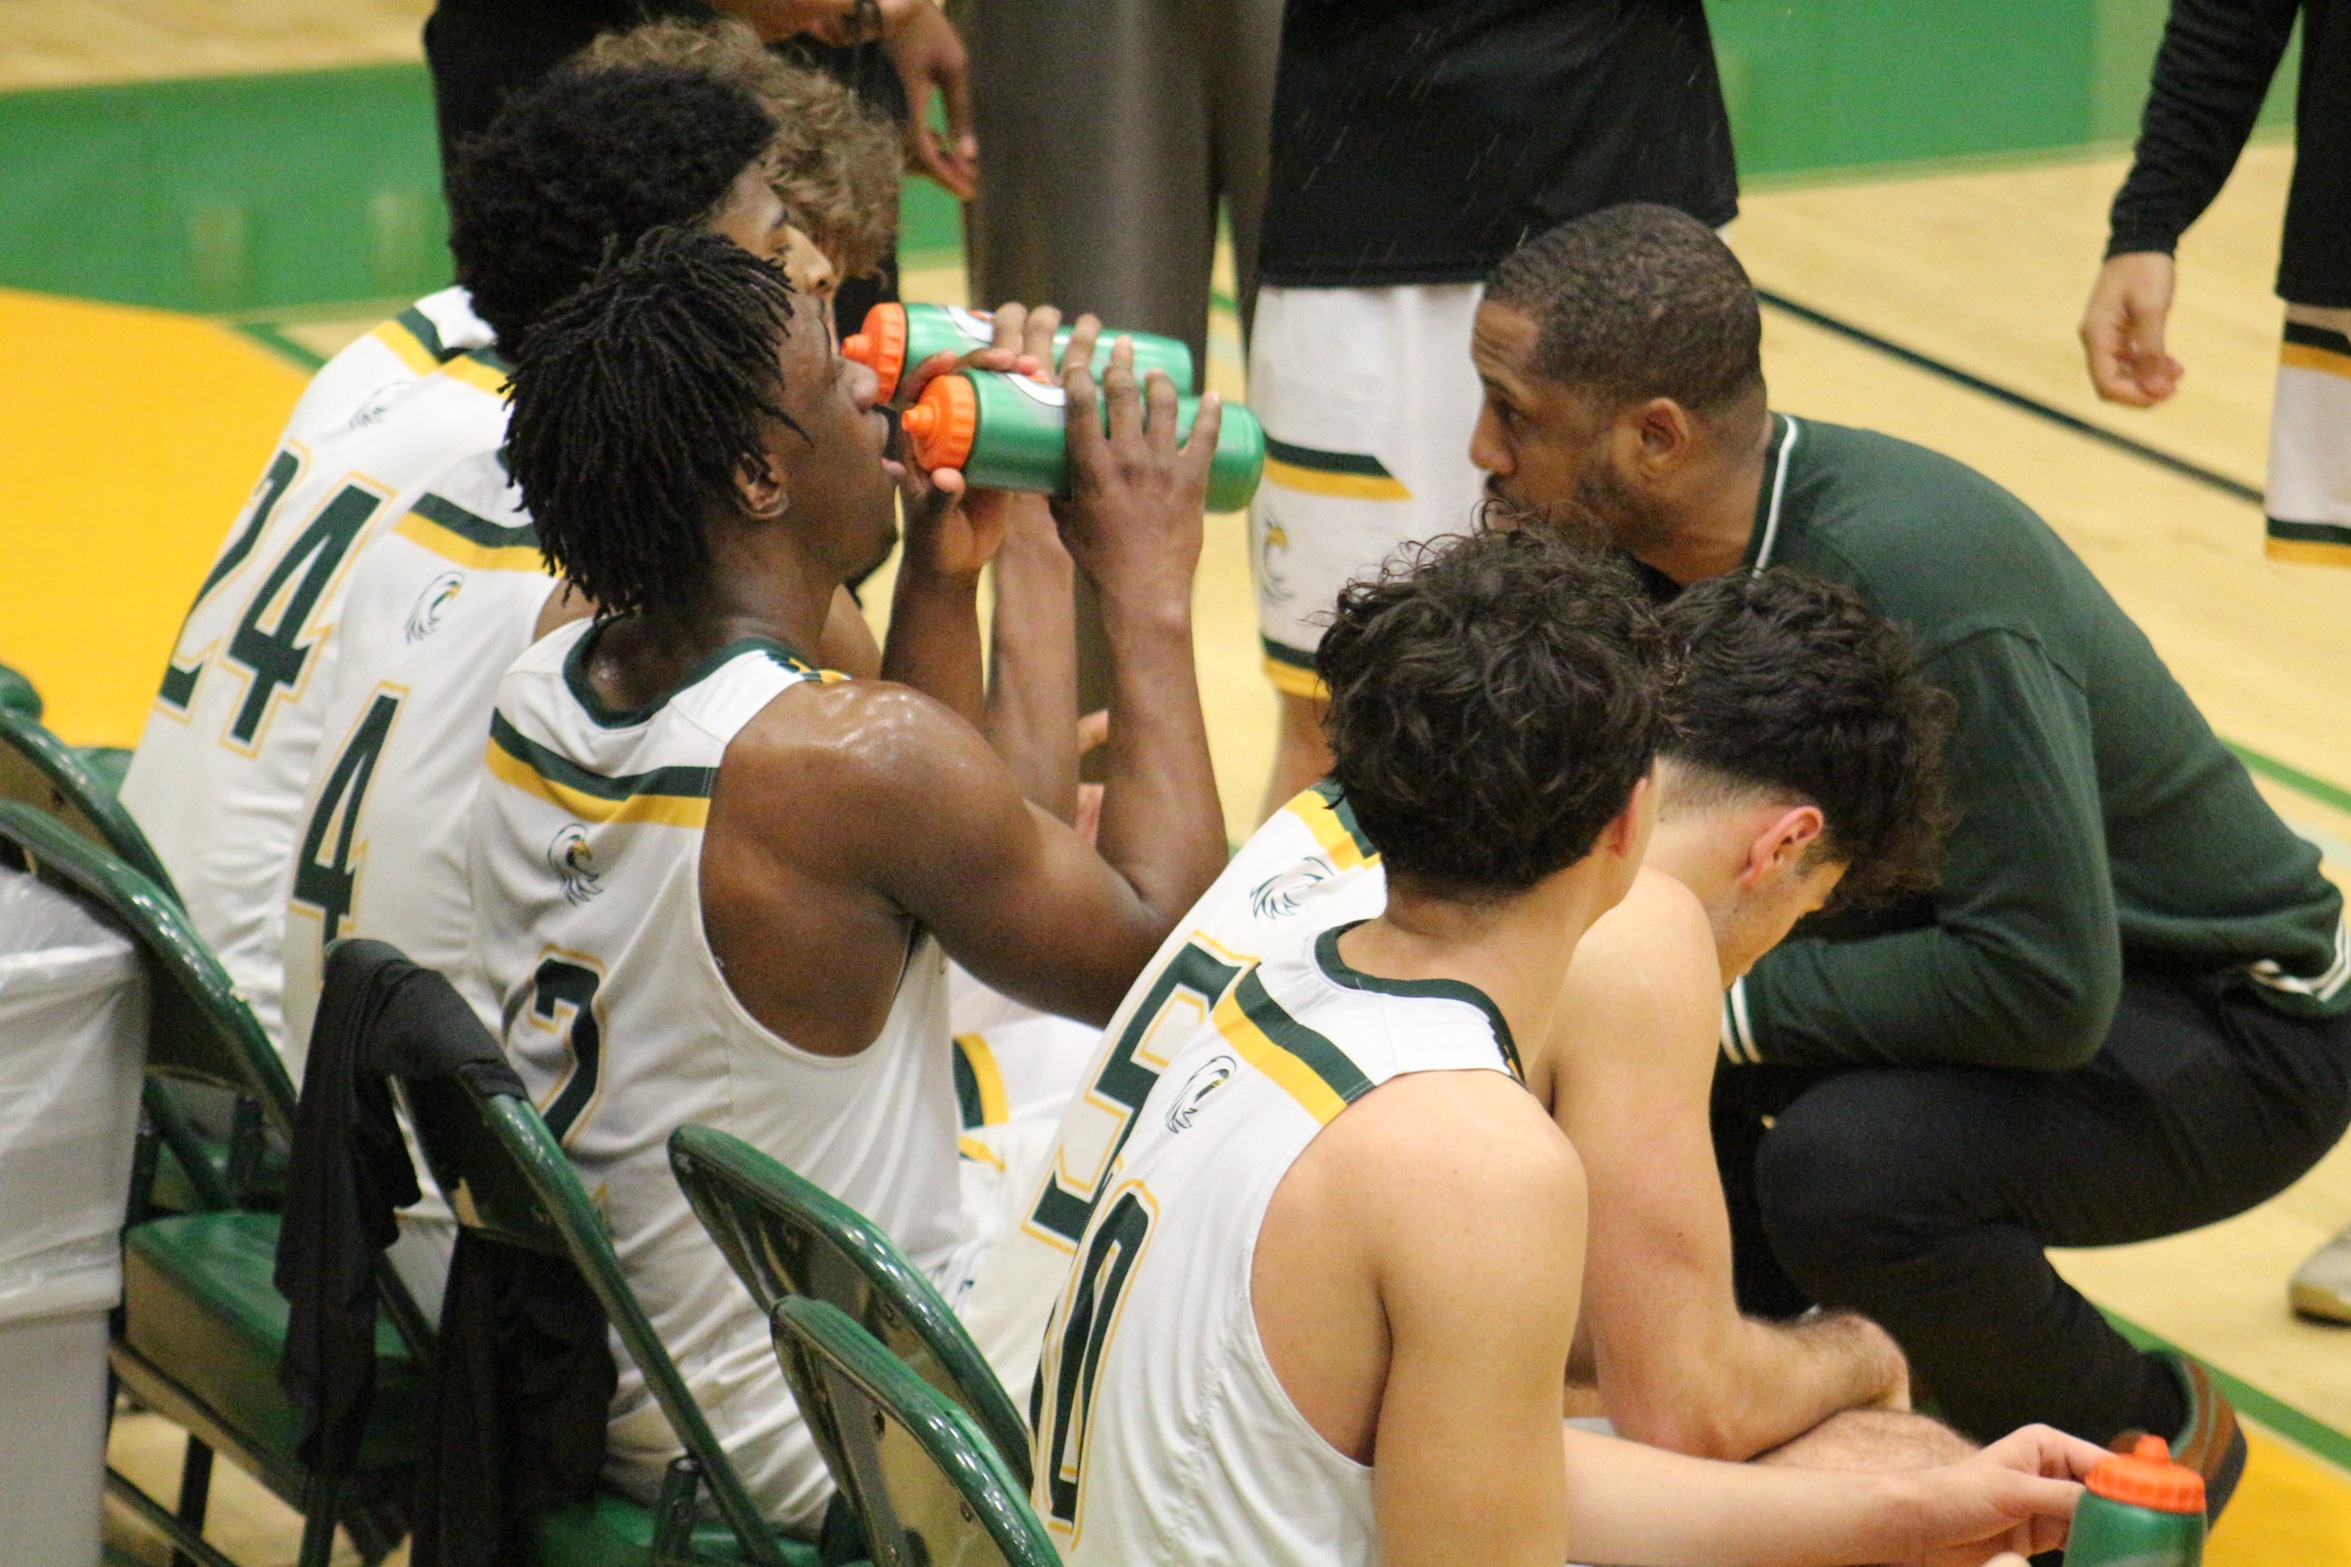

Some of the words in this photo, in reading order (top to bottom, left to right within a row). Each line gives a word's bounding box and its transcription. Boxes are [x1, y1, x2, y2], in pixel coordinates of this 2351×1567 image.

[153, 438, 399, 760] 24
[288, 680, 411, 962] 4
[1020, 928, 1262, 1258] 5
